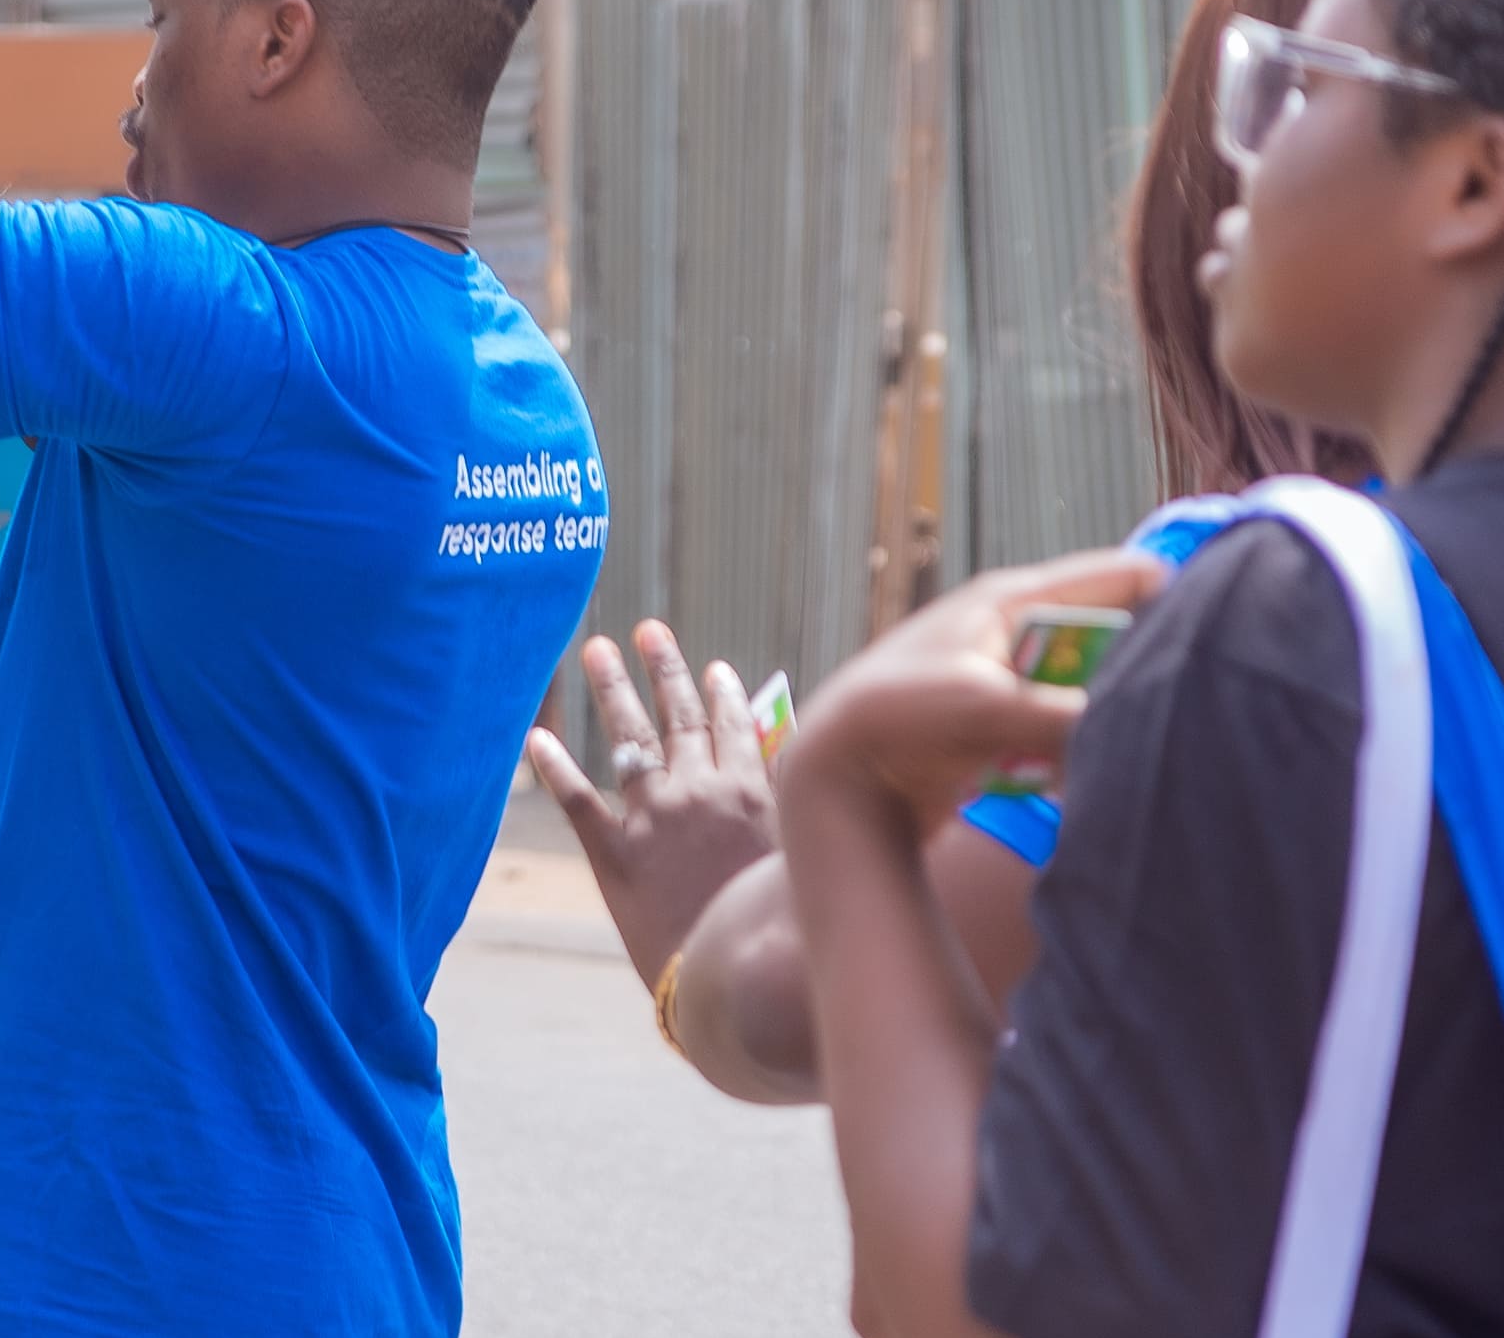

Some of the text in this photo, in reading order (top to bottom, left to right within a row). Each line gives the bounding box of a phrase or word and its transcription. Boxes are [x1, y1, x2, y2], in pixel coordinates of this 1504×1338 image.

[455, 450, 603, 505] Assembling a
[438, 519, 546, 565] response
